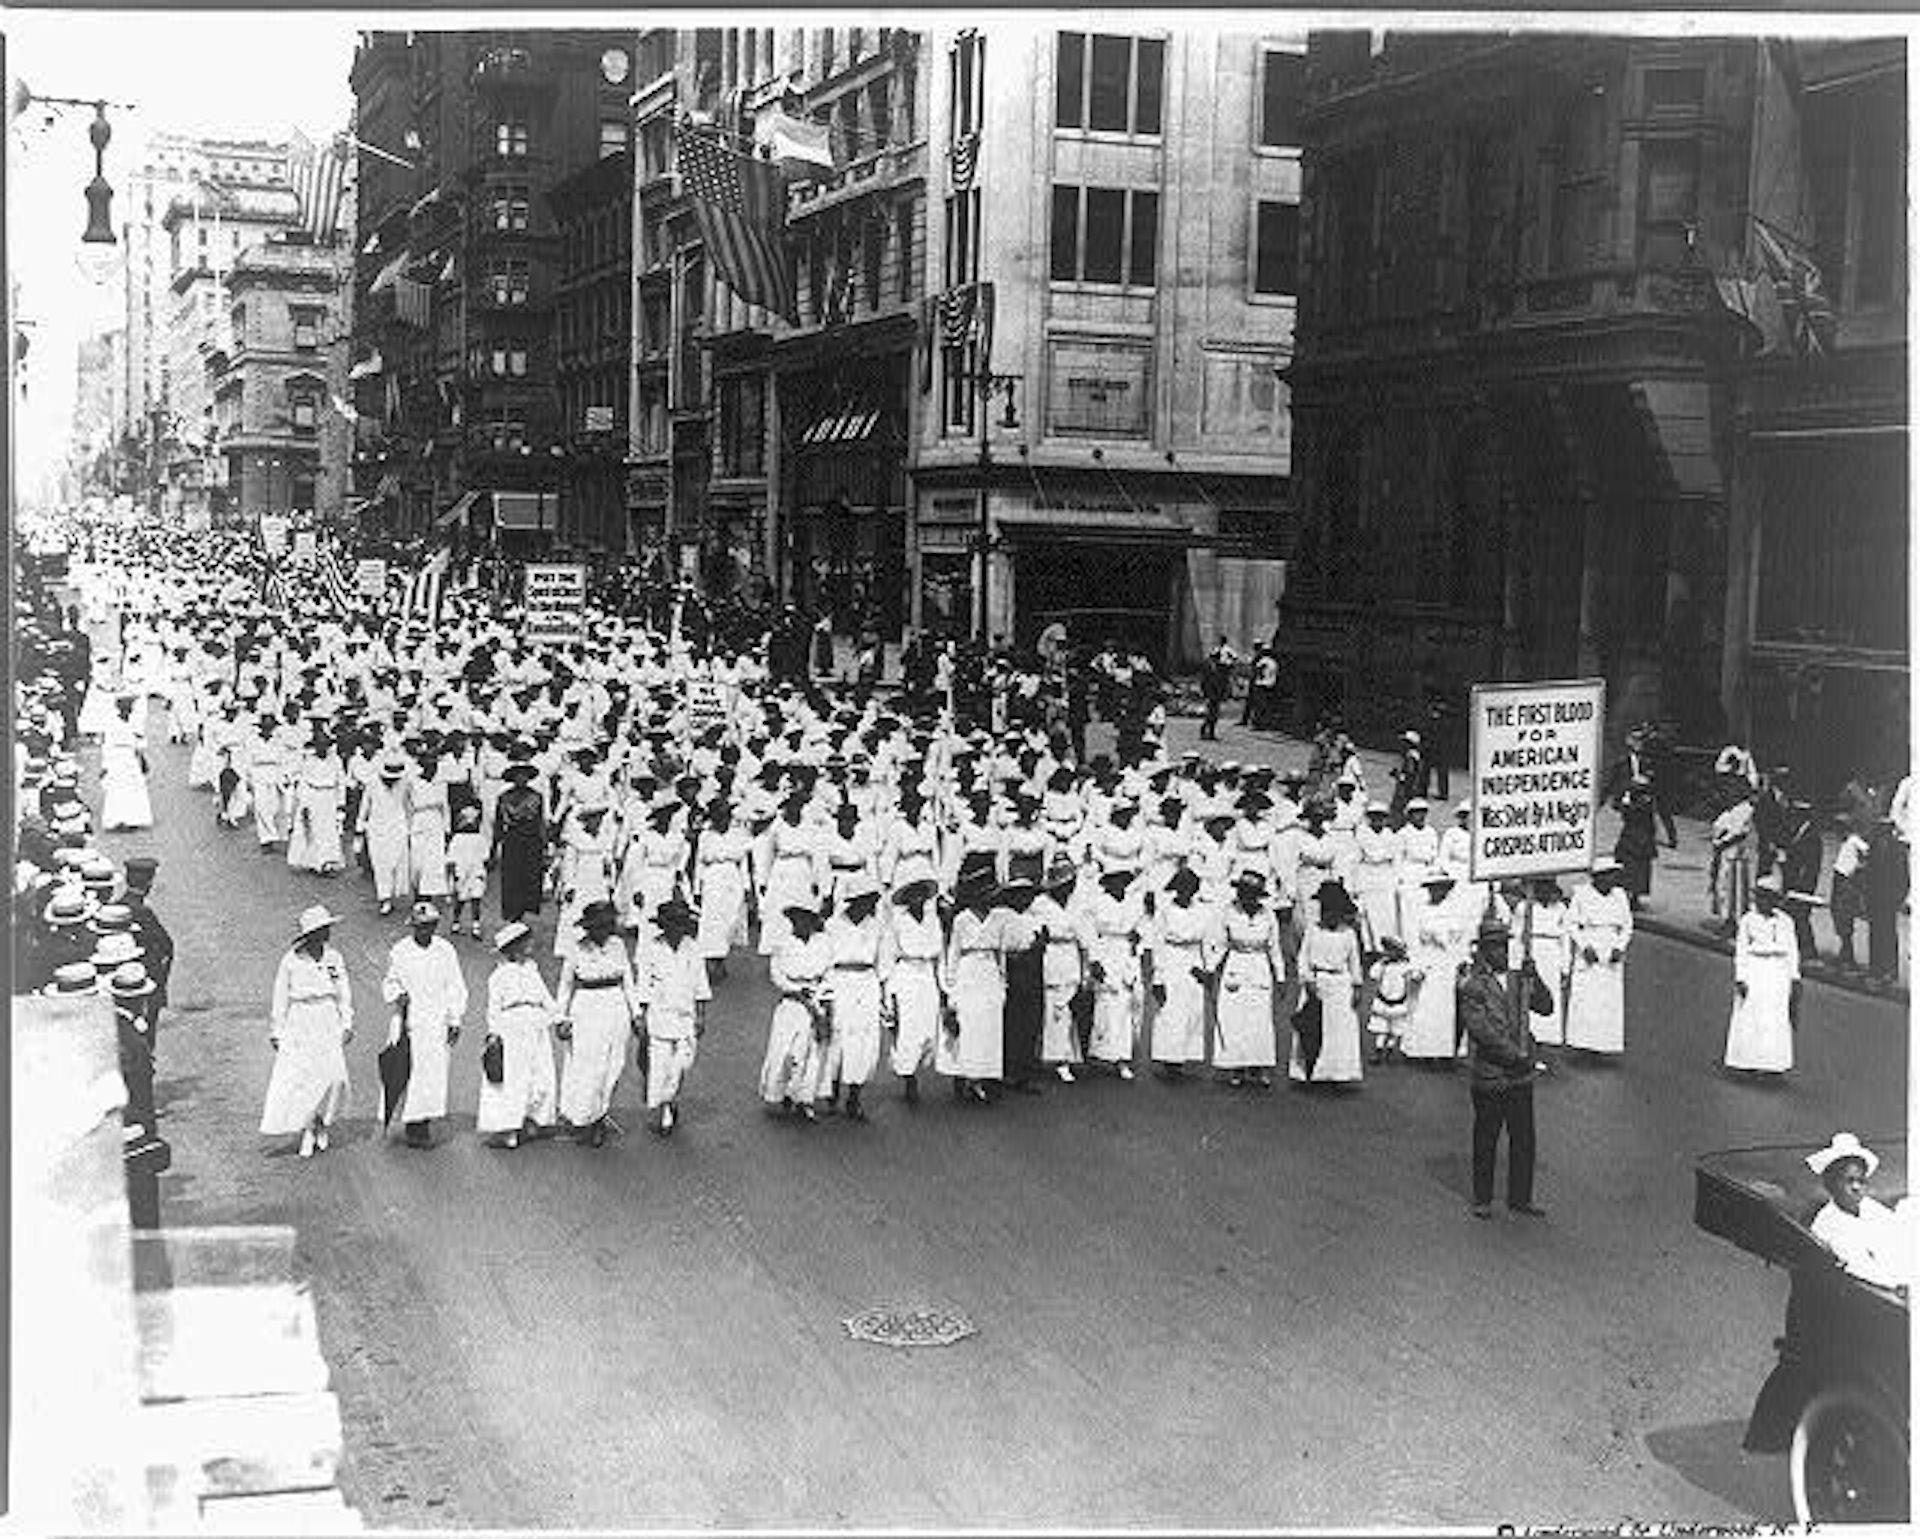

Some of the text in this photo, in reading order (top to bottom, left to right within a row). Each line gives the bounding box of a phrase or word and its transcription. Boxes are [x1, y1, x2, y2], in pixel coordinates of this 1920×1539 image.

[1486, 700, 1593, 727] THE FIRST BLOOD
[1517, 728, 1557, 742] FOR
[1491, 745, 1577, 767] AMERICAN
[1482, 768, 1589, 794] INDEPENDENCE
[1485, 829, 1584, 857] CRISPUS ATTUCKS
